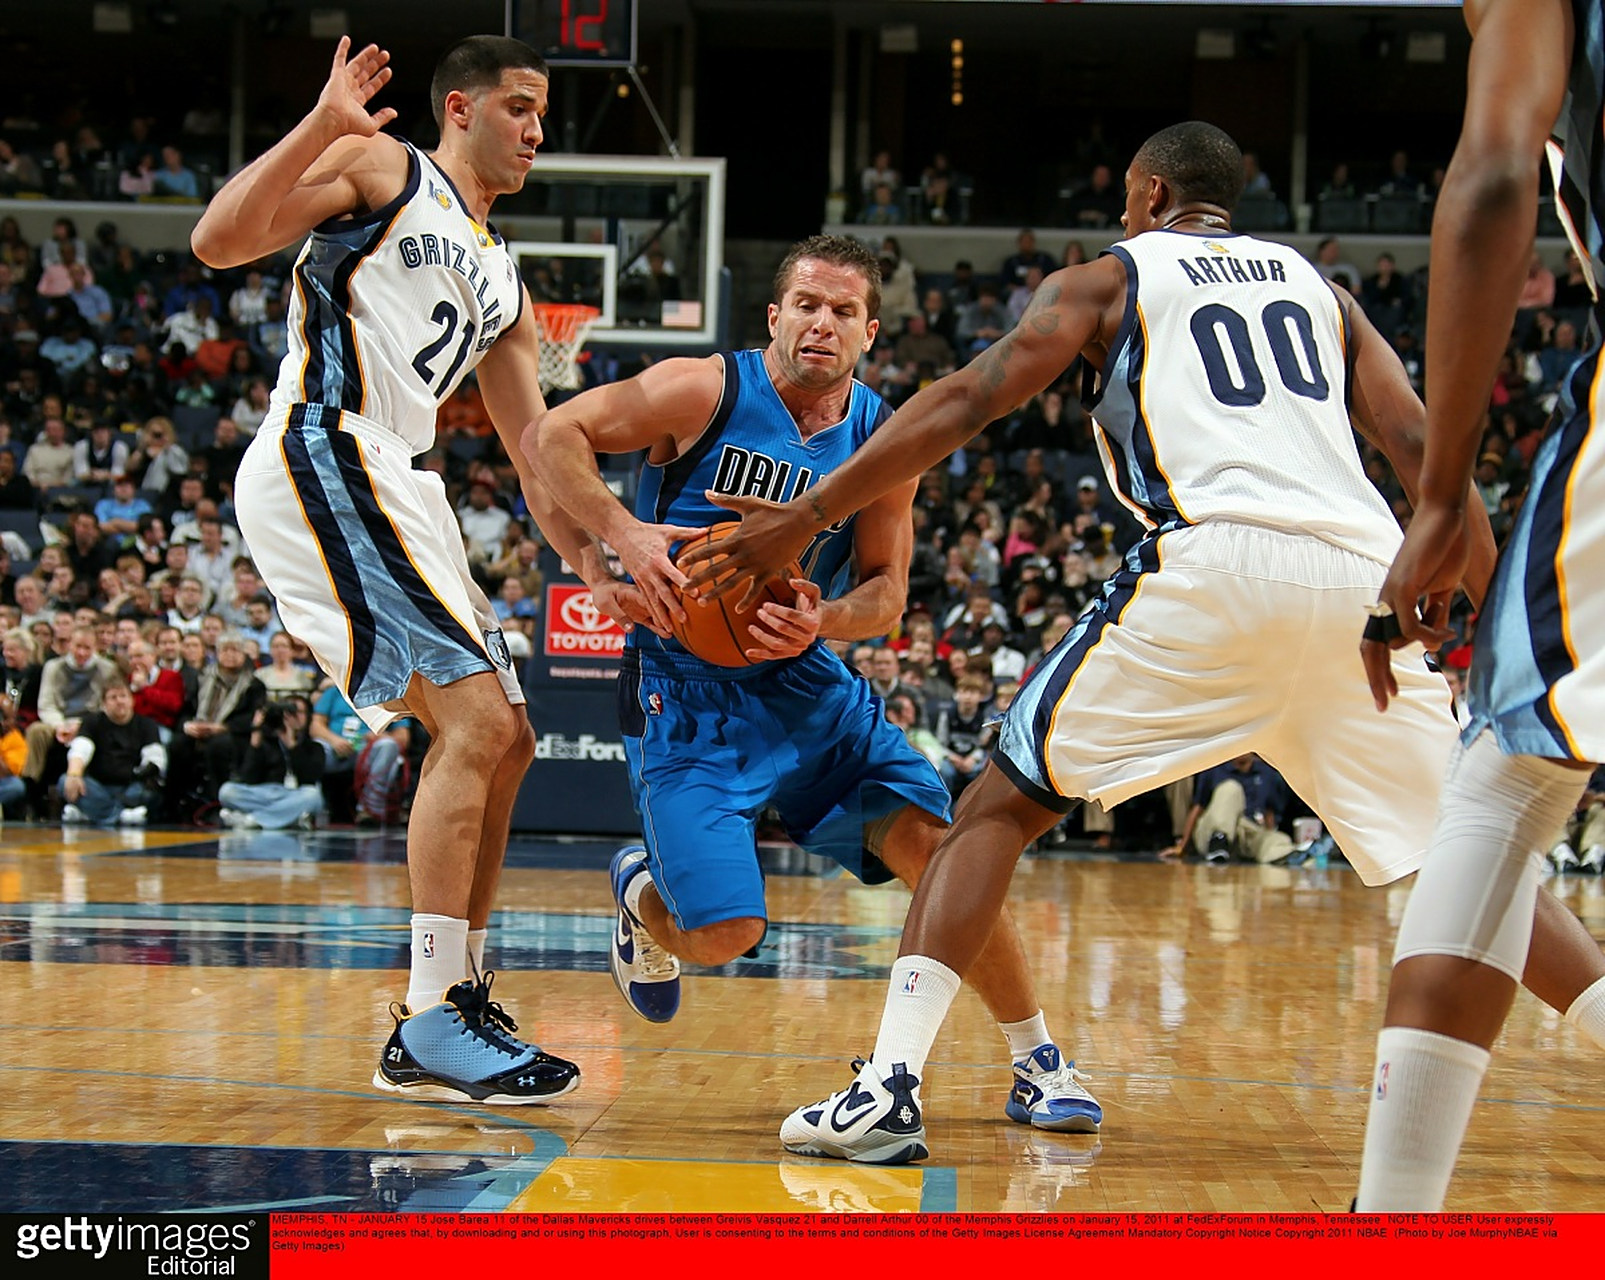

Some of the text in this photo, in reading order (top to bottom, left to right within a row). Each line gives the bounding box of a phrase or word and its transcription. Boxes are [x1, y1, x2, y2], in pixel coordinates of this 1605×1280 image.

[560, 0, 608, 49] 12
[398, 233, 503, 353] GRIZZLIES
[1178, 256, 1287, 286] ARTHUR
[411, 300, 476, 400] 21
[1190, 300, 1329, 407] 00
[550, 631, 626, 651] TOYOTA
[387, 1046, 404, 1063] 21
